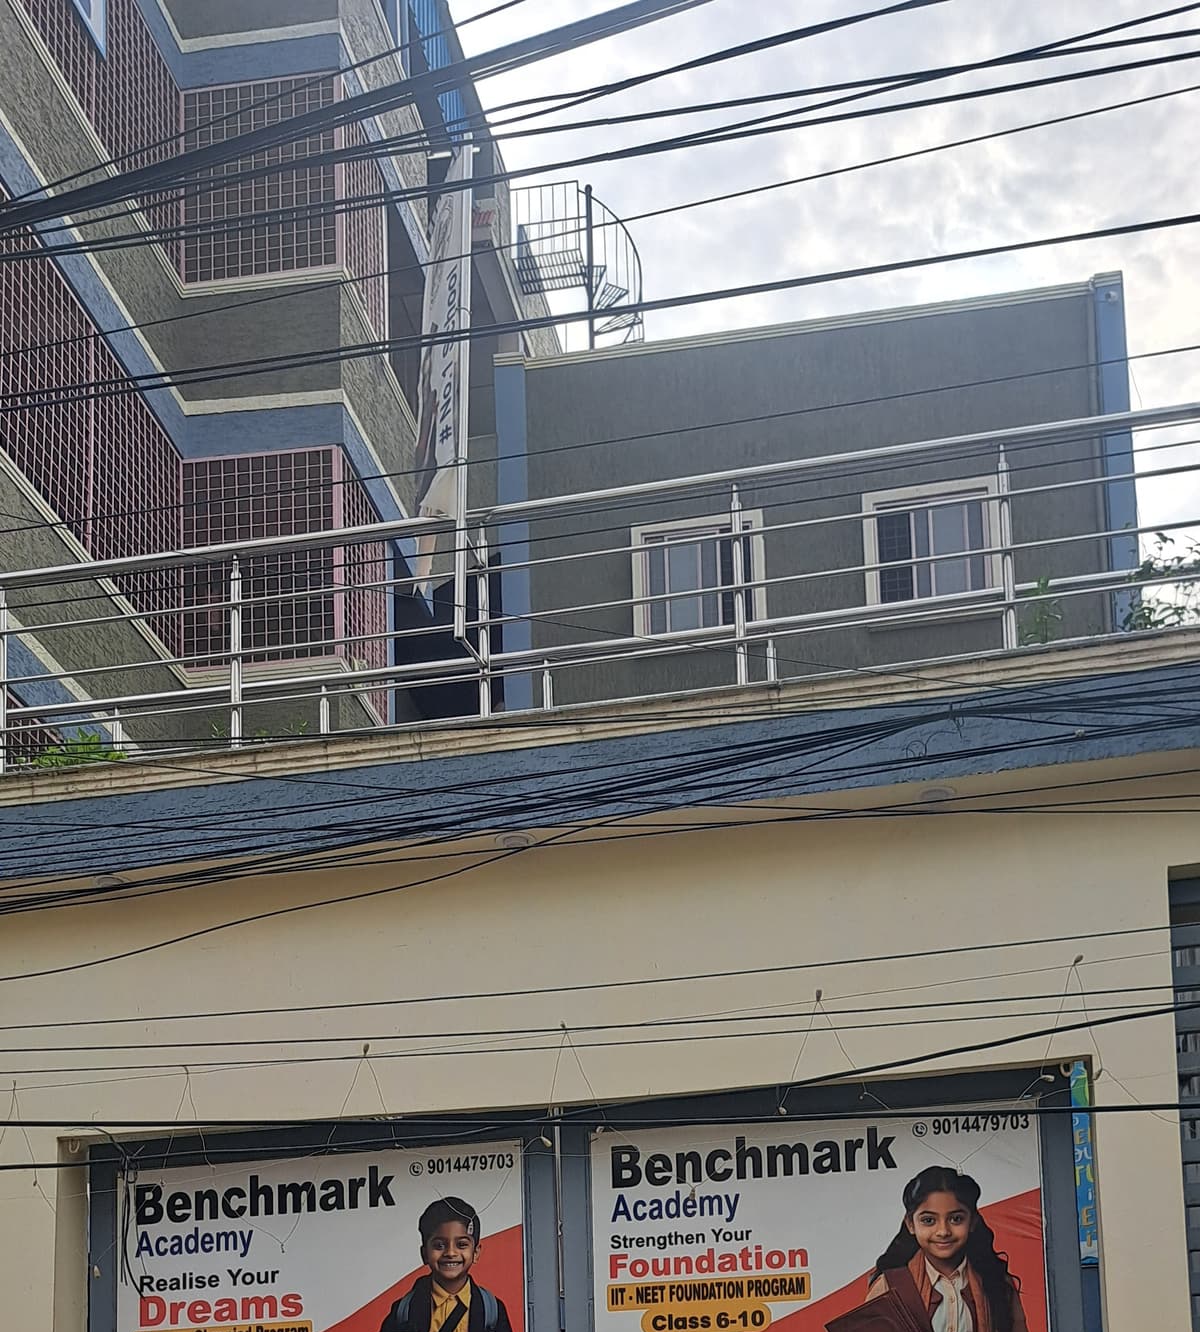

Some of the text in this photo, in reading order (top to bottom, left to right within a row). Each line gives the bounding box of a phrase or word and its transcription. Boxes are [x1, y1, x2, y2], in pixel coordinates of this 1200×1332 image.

[932, 1113, 1030, 1136] 9014479703
[427, 1153, 514, 1175] 9014479703
[611, 1126, 897, 1188] Benchmark
[135, 1165, 395, 1226] Benchmark
[611, 1190, 740, 1222] Academy
[135, 1228, 254, 1258] Academy
[610, 1228, 753, 1250] Strengthen Your
[609, 1245, 809, 1279] Foundation
[139, 1268, 280, 1293] Realise Your
[611, 1290, 625, 1306] IIT
[635, 1287, 666, 1304] NEET
[669, 1281, 745, 1303] FOUNDATION
[746, 1278, 806, 1297] PROGRAM
[139, 1294, 304, 1328] Dreams
[651, 1311, 764, 1331] Class 6-10
